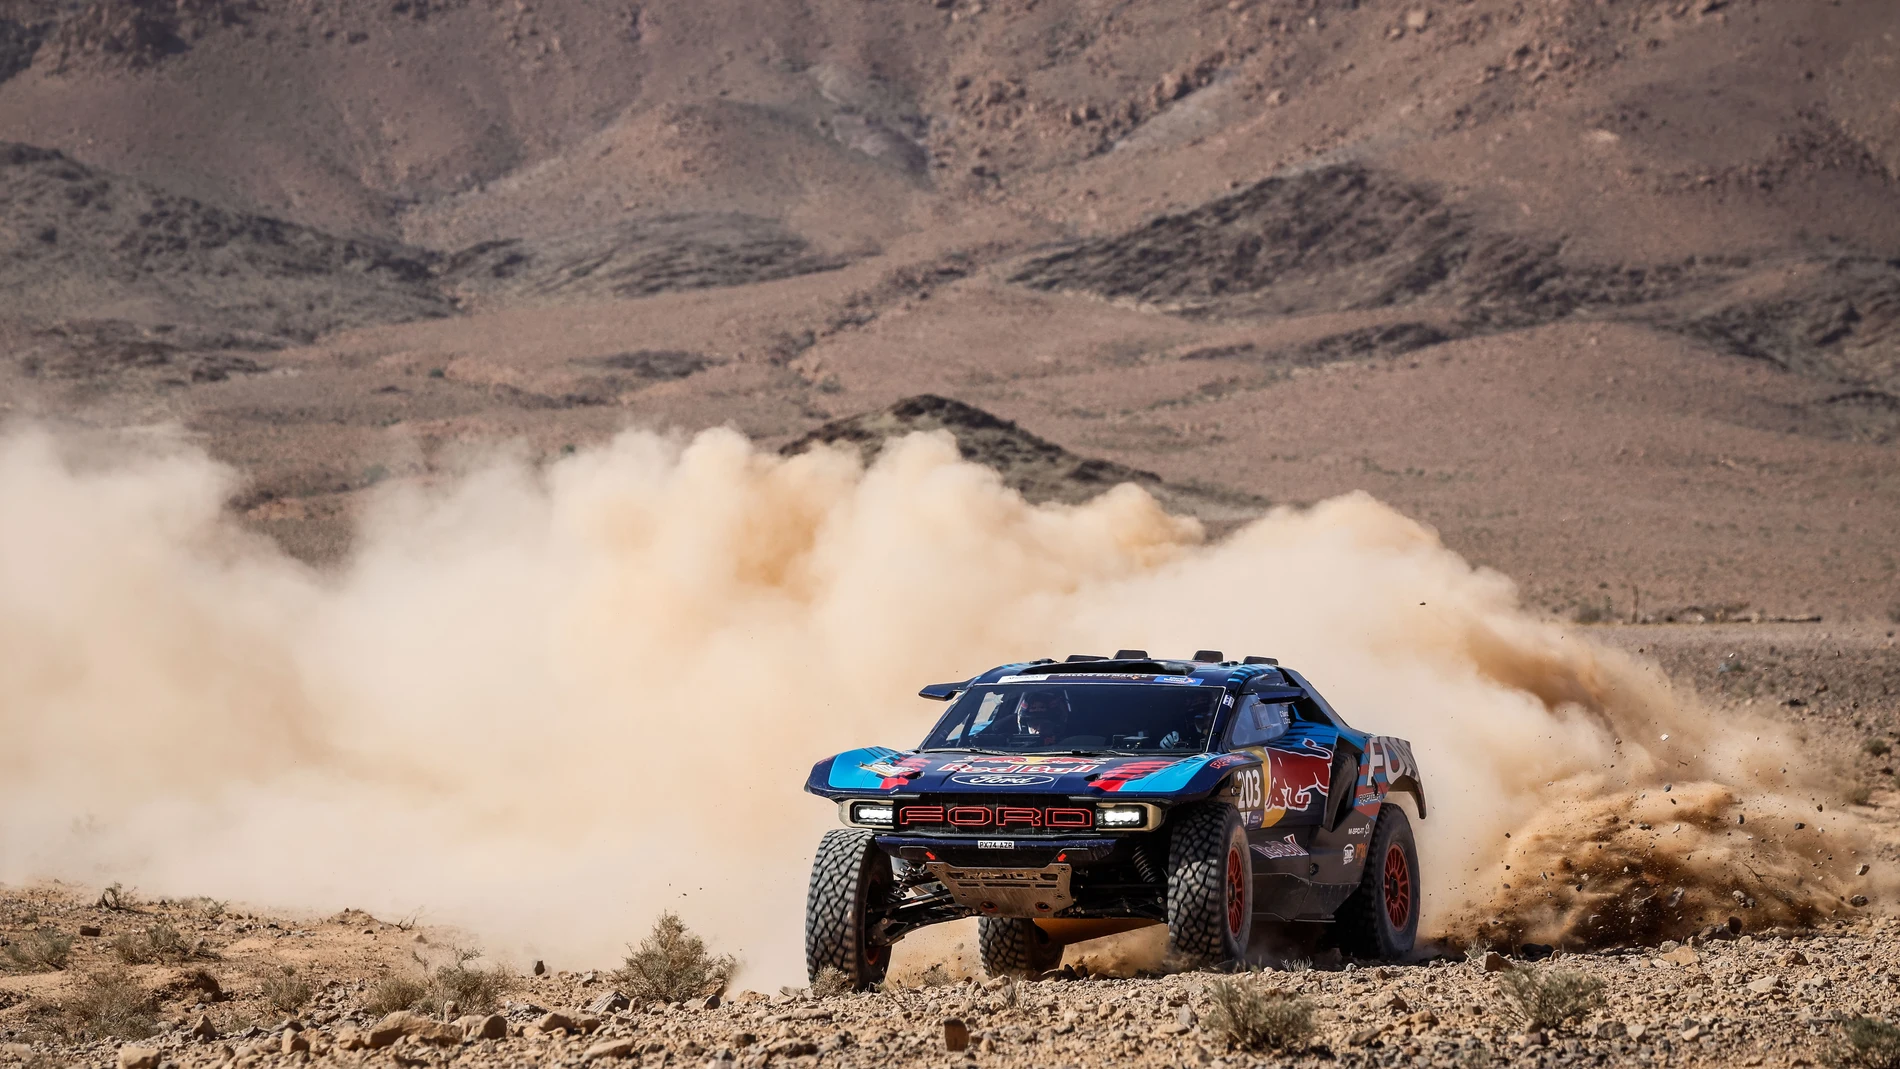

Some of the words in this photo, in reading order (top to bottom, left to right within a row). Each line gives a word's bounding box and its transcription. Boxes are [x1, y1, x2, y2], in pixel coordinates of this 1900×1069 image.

[936, 763, 1002, 774] Red
[1018, 764, 1100, 774] Bull
[970, 775, 1035, 785] Ford
[1237, 769, 1260, 809] 203
[900, 805, 1092, 827] FORD
[979, 841, 997, 849] PX74
